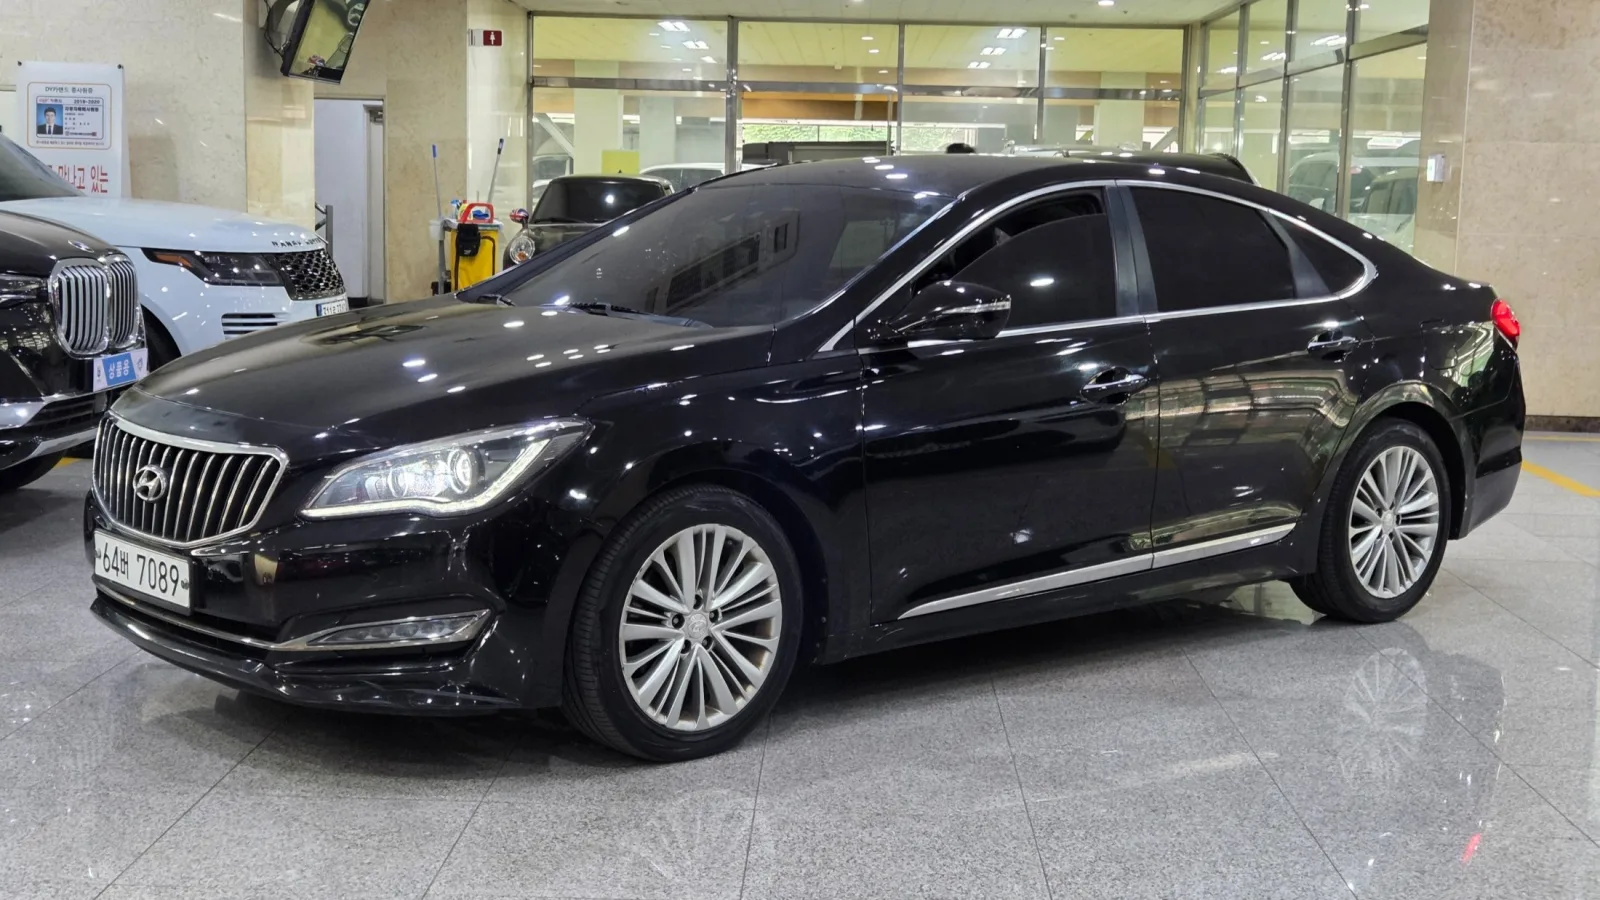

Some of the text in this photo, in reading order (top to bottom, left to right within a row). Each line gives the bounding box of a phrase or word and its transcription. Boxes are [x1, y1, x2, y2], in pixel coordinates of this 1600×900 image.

[90, 164, 109, 193] 있는
[108, 359, 130, 380] 상품용
[102, 541, 180, 597] 64버 7089
